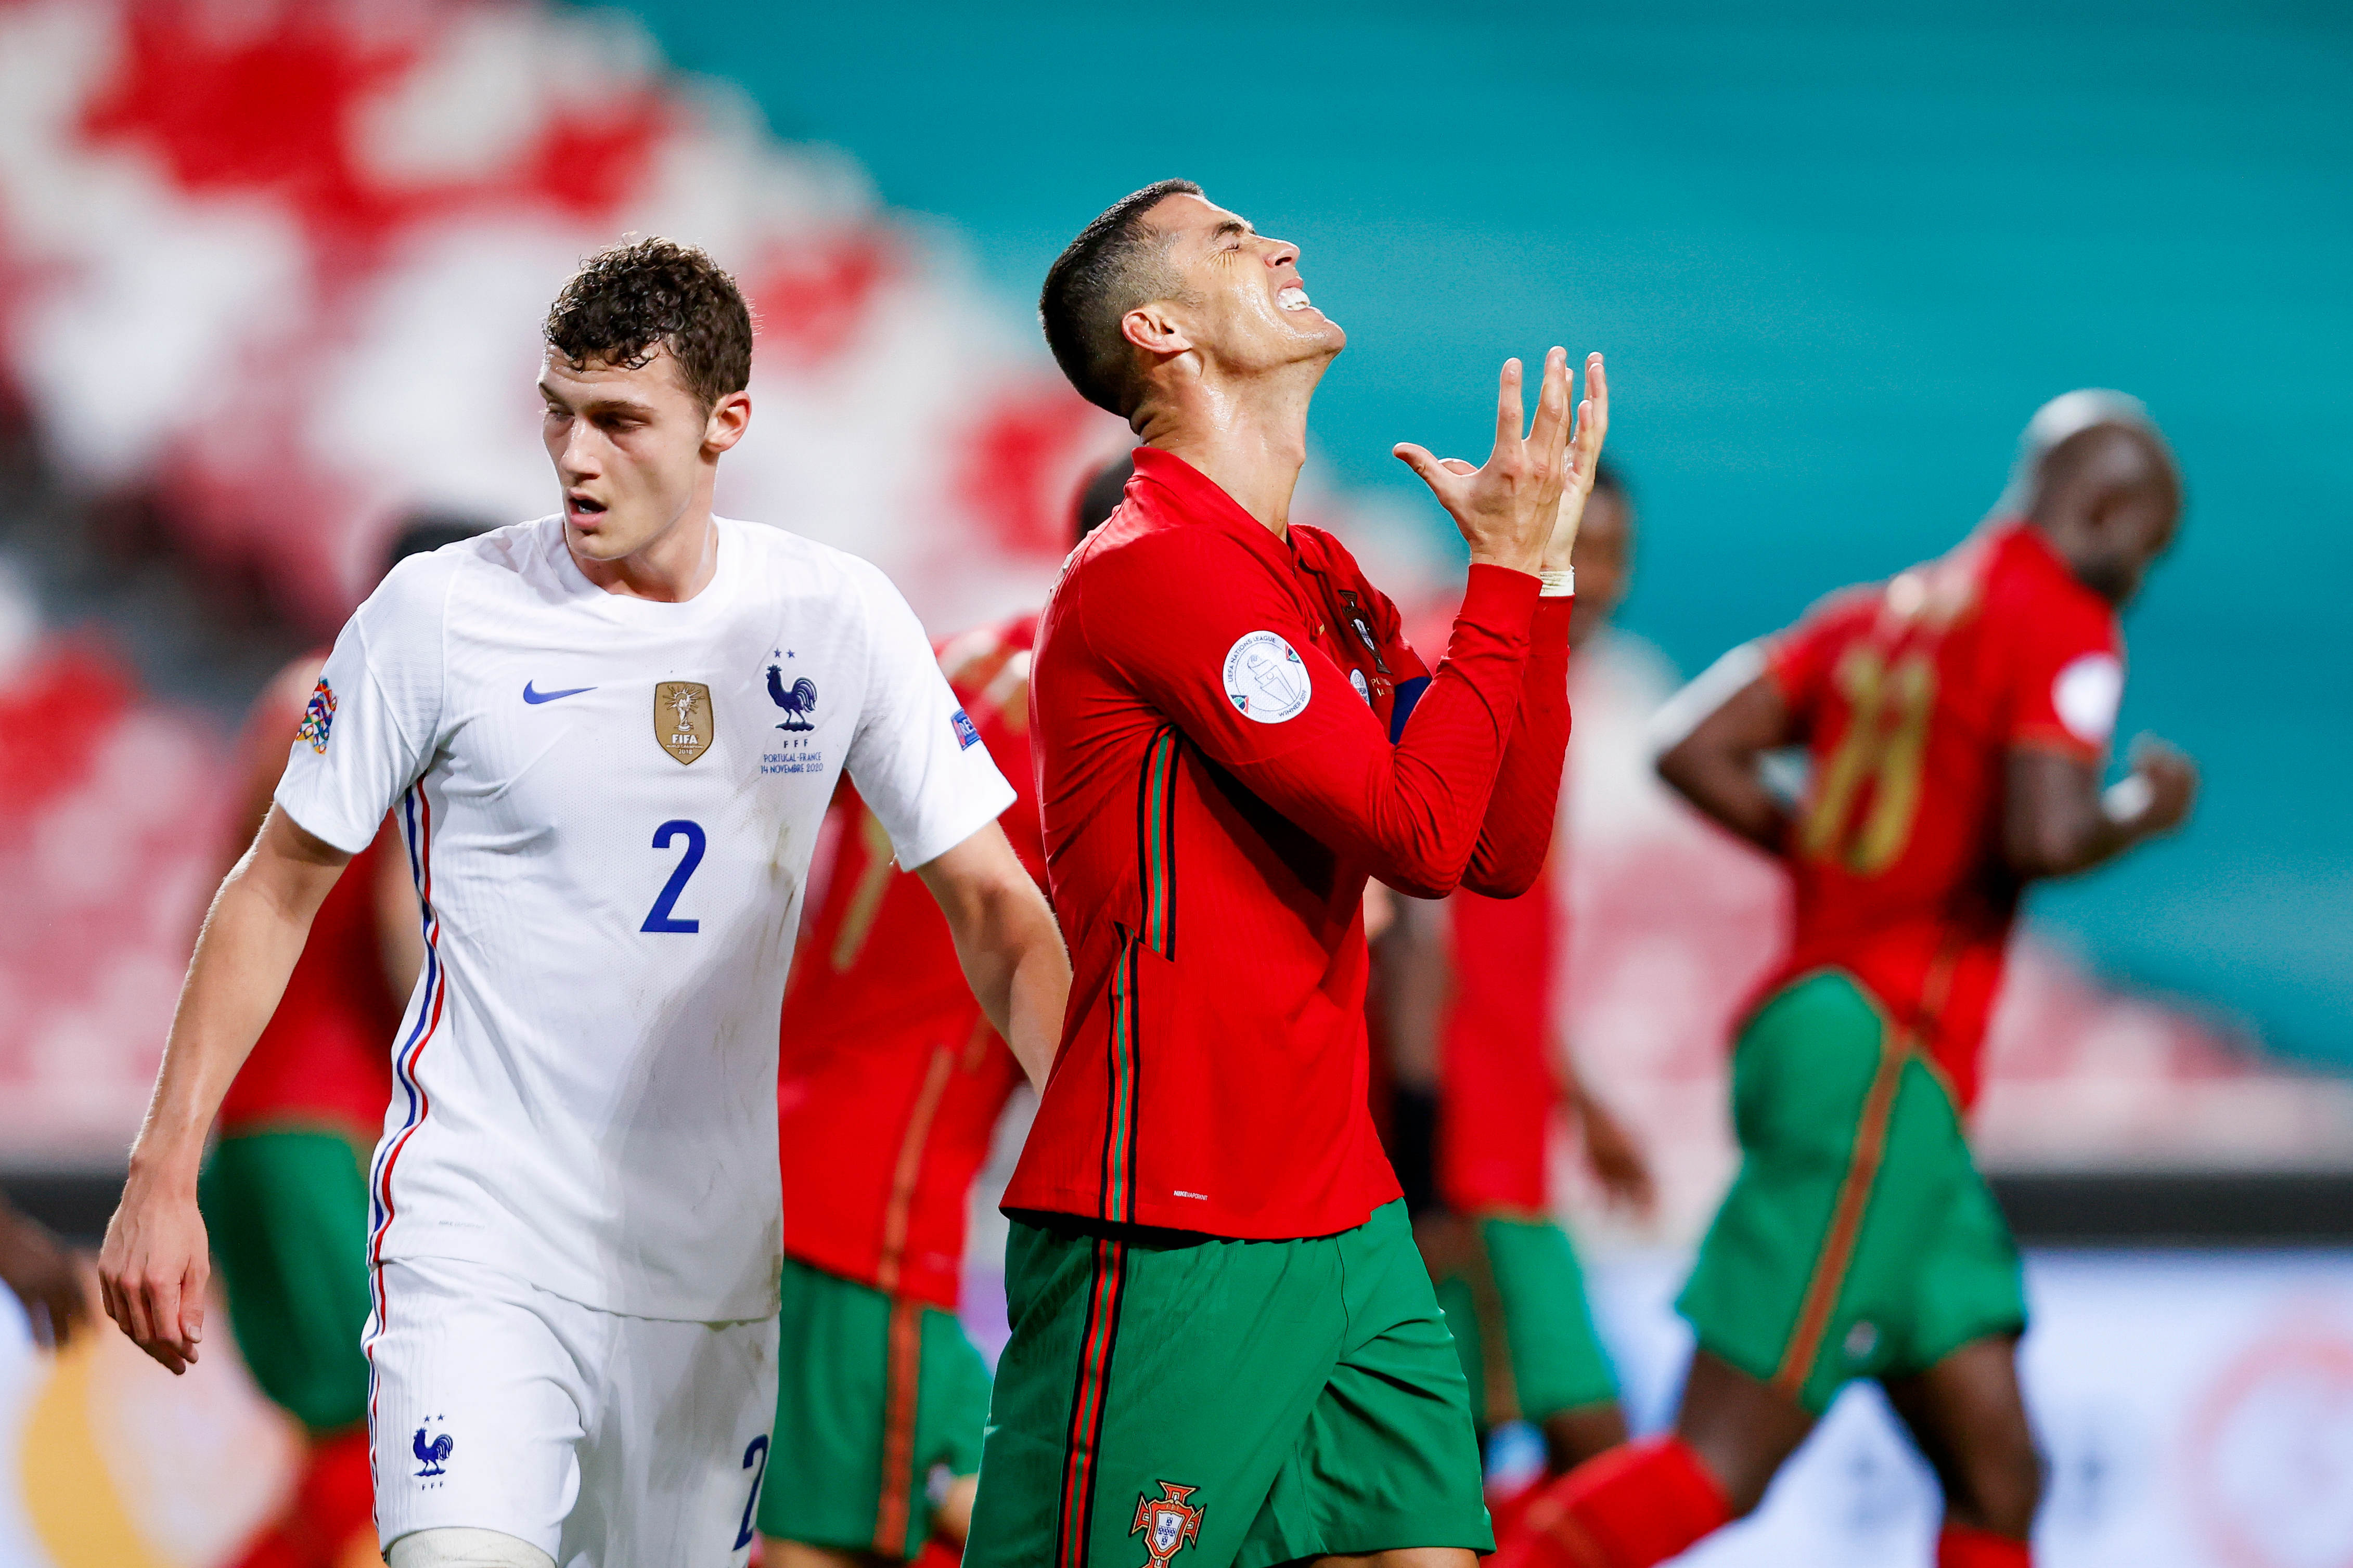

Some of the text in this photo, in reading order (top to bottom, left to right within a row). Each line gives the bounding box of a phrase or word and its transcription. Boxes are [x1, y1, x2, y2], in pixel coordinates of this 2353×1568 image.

[1231, 639, 1252, 663] NATIONS
[1279, 701, 1302, 717] WINNER
[672, 734, 698, 744] FIFA
[761, 762, 824, 774] 14 NOVEMBRE 2020
[640, 819, 706, 933] 2
[732, 1433, 768, 1551] 2
